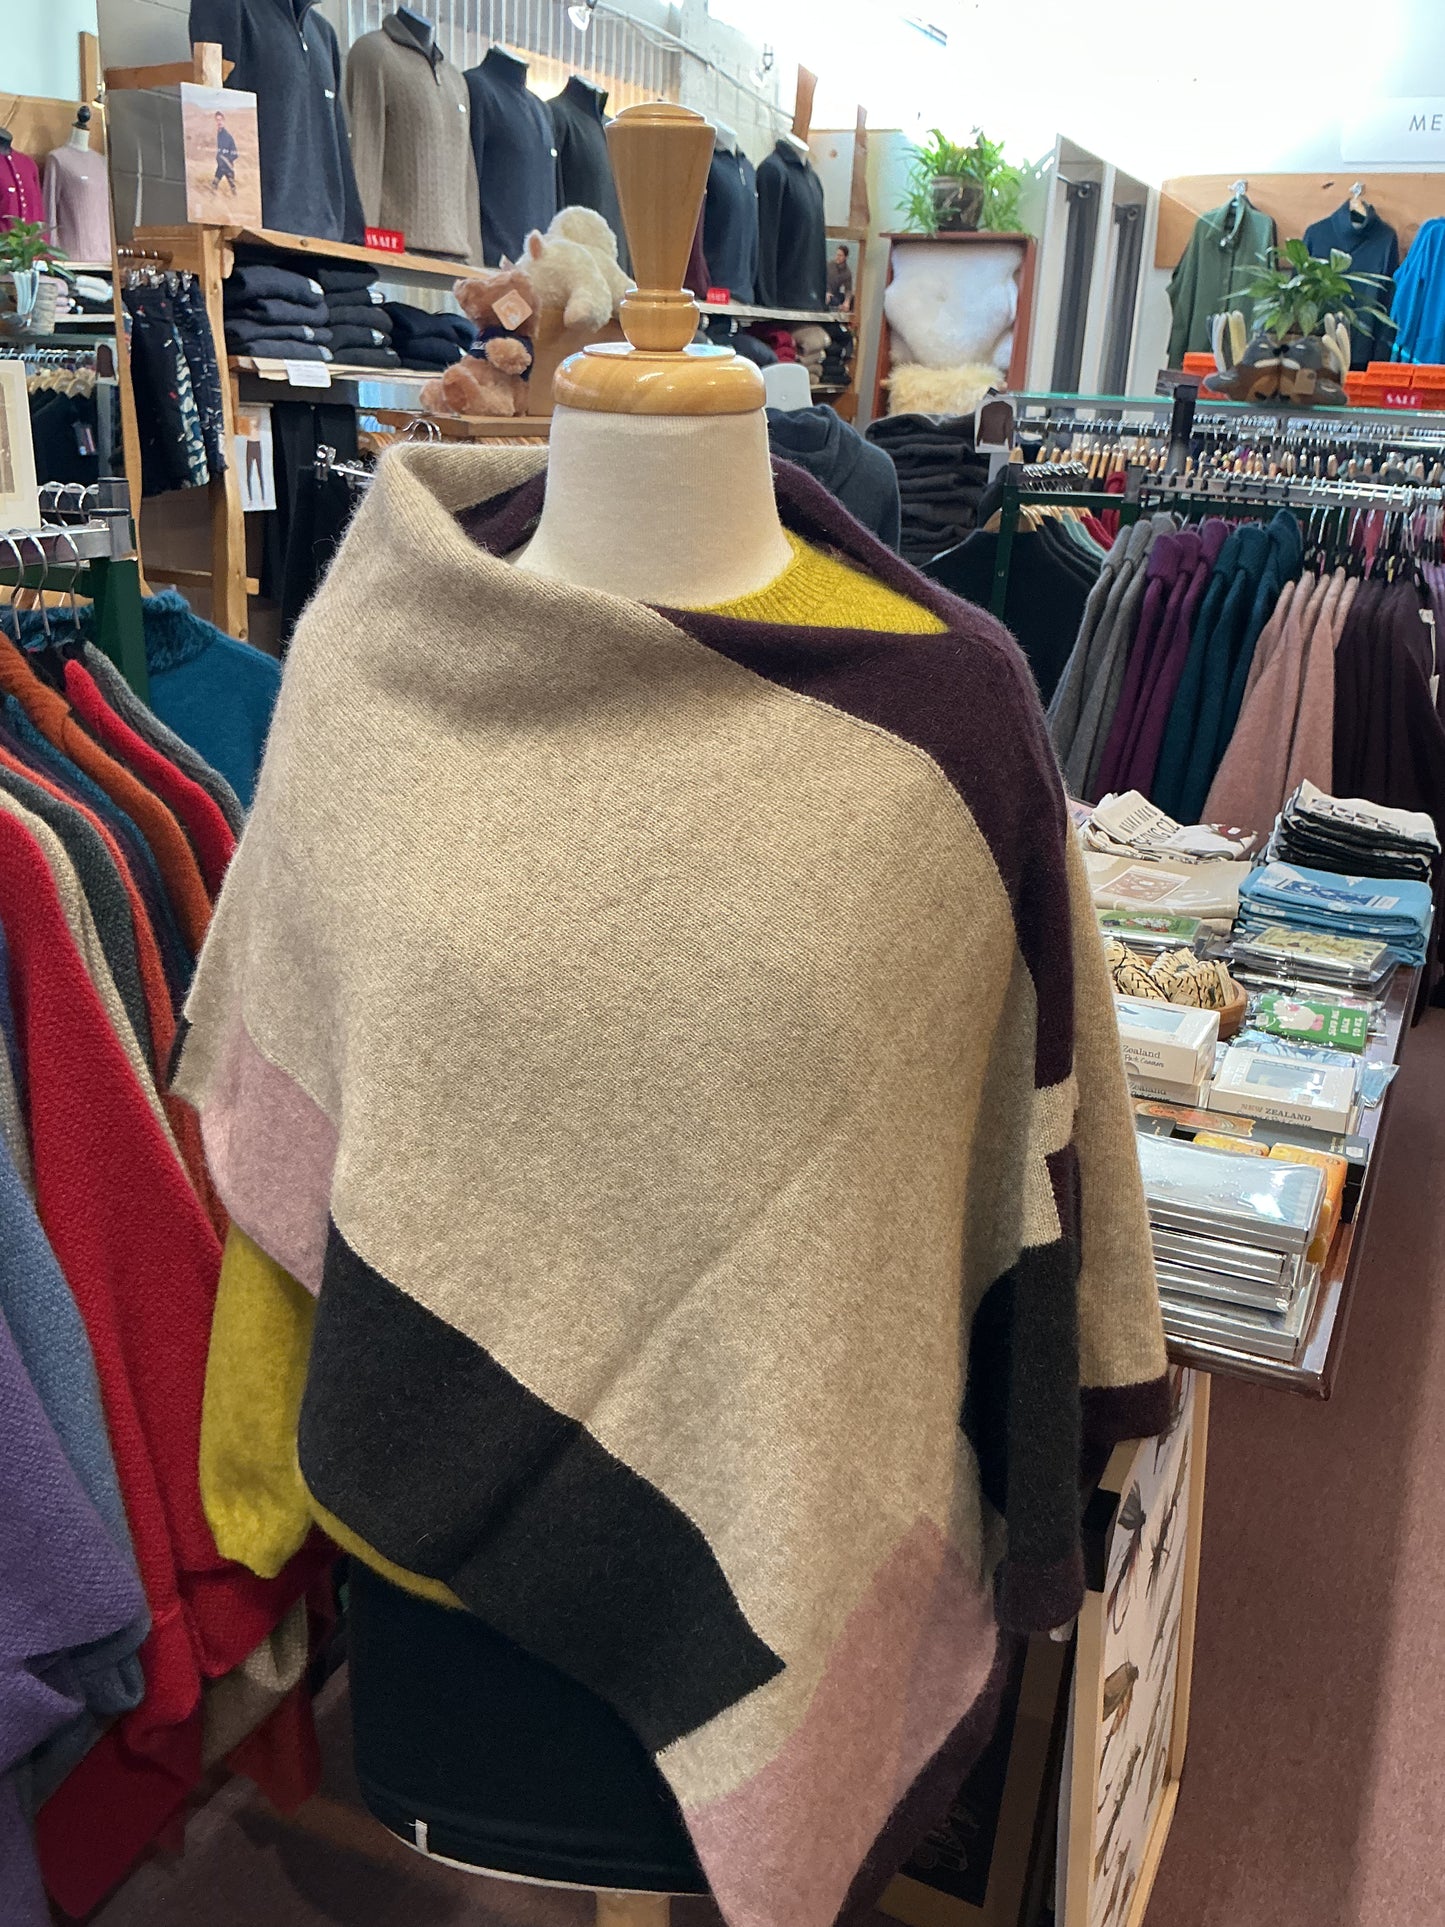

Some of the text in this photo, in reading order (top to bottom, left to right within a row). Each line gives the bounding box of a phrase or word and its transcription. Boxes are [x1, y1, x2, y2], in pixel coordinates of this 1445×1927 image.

[1408, 113, 1443, 132] ME
[1122, 1044, 1161, 1059] Zealand
[1265, 1107, 1312, 1122] ZEALAND
